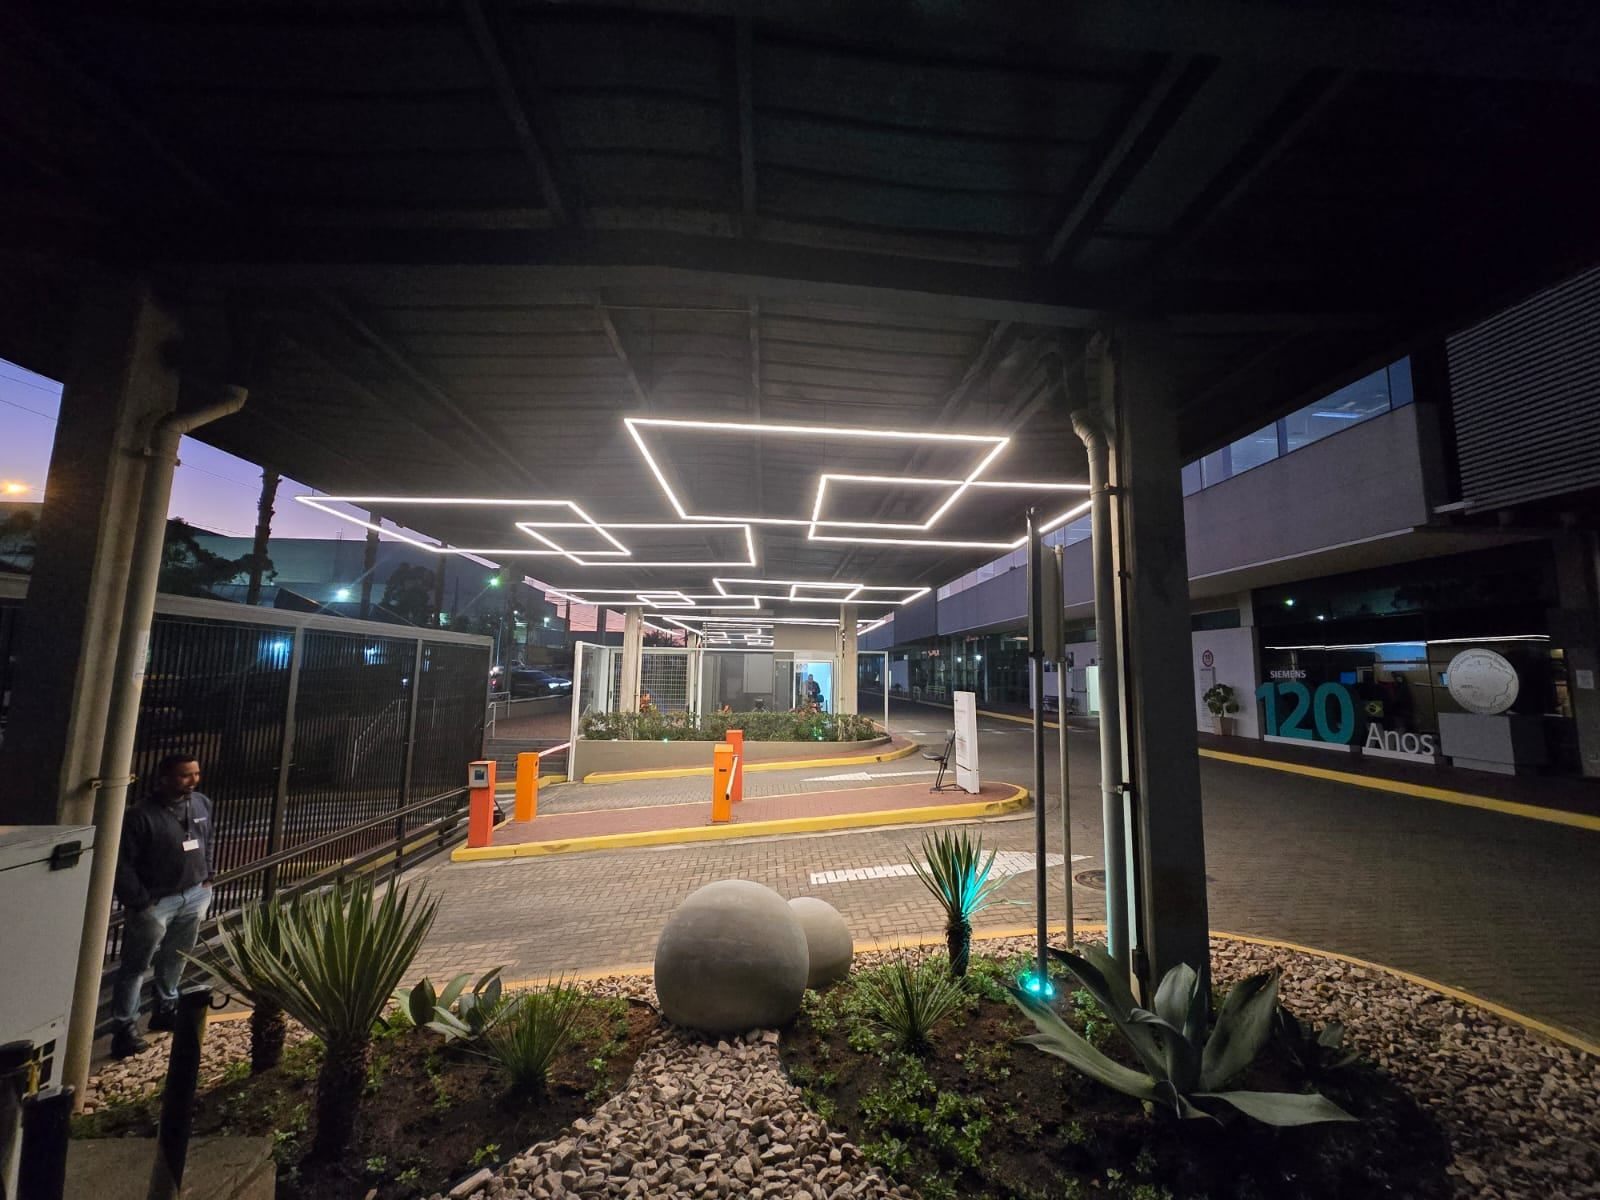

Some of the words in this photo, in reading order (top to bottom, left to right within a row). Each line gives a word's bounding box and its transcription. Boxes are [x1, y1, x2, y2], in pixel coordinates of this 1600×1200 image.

[1270, 670, 1307, 679] SIEMENS
[1255, 682, 1354, 745] 120
[1365, 722, 1435, 756] Anos
